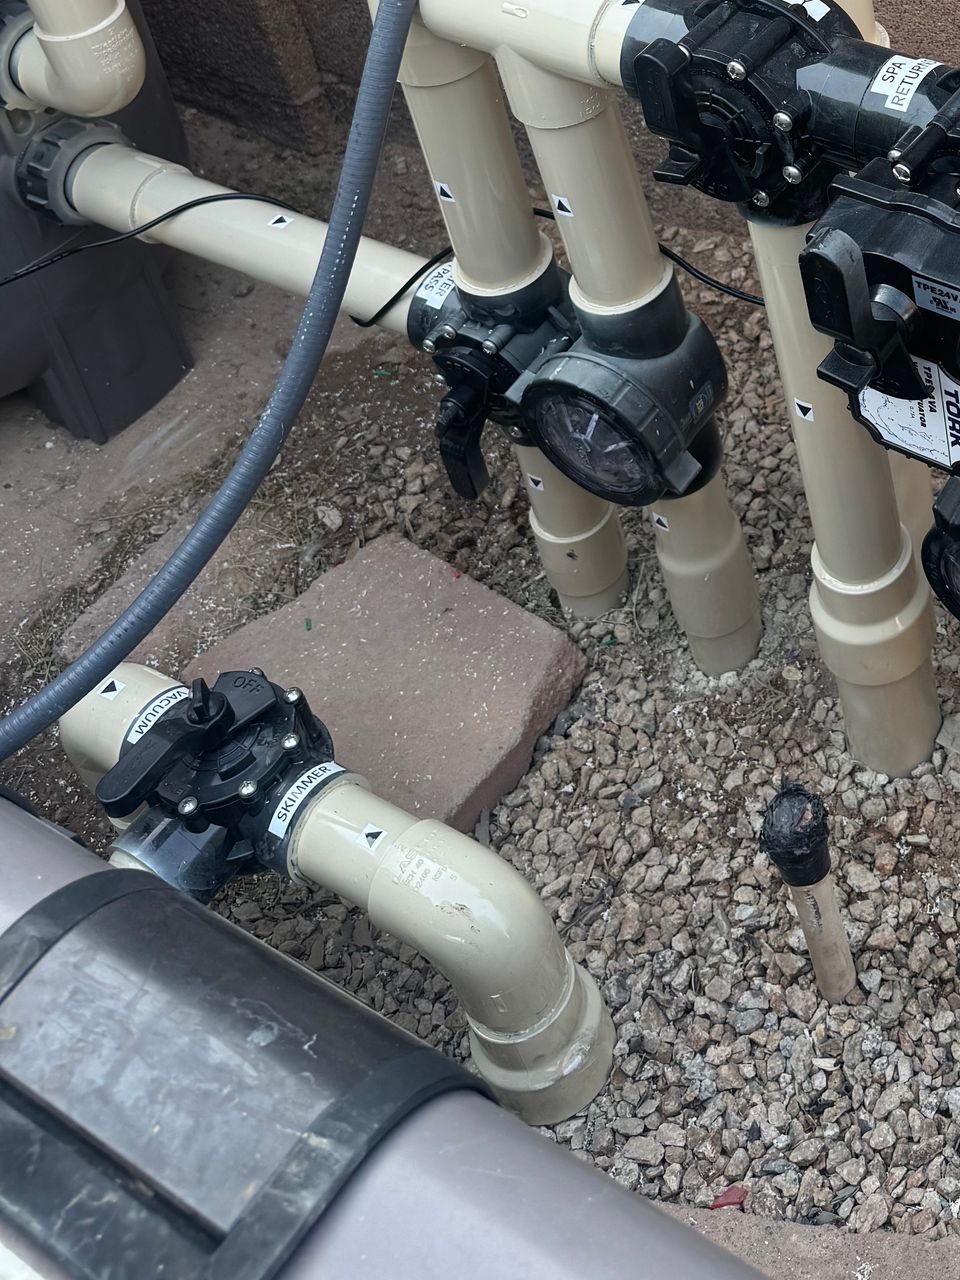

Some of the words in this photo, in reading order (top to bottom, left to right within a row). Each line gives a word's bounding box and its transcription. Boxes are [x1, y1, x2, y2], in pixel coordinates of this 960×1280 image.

[882, 63, 906, 83] SPA
[424, 265, 451, 292] PASS
[436, 275, 455, 297] TER
[234, 676, 264, 693] OFF
[135, 691, 187, 735] VACUUM
[276, 765, 331, 822] SKIMMER
